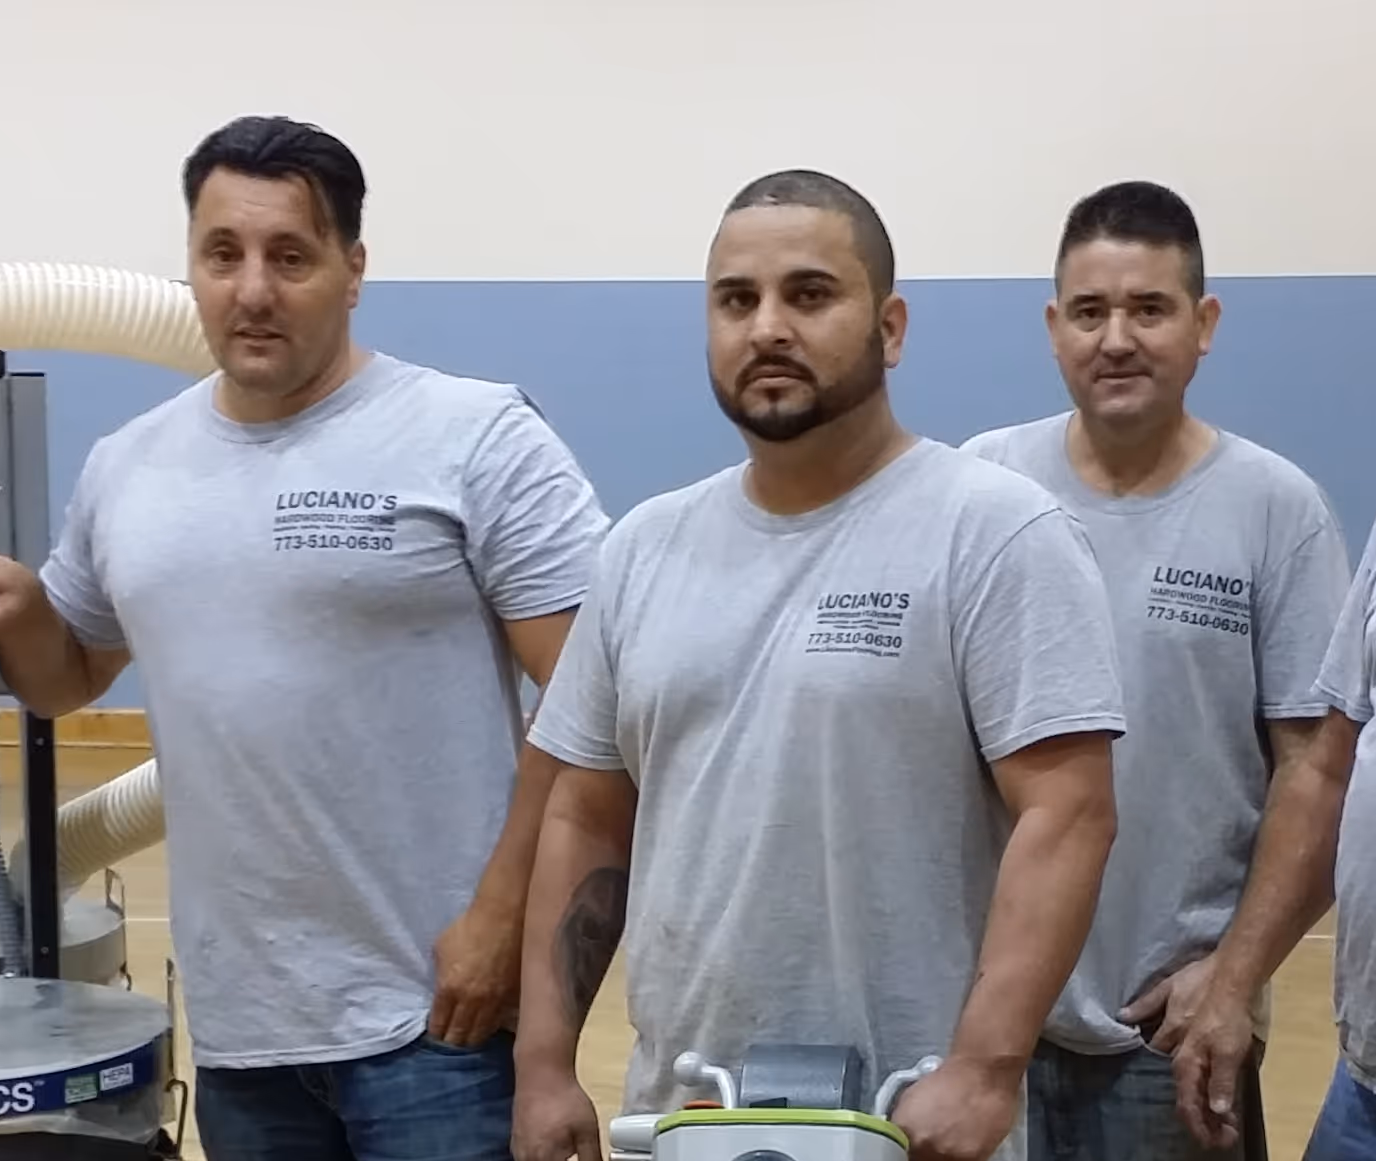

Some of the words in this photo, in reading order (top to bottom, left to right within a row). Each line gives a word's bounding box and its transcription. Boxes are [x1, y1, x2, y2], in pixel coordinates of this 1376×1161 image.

[276, 490, 398, 510] LUCIANO'S
[274, 534, 393, 551] 773-510-0630
[1153, 566, 1252, 596] LUCIANO'
[817, 591, 910, 610] LUCIANO'S
[1146, 605, 1249, 636] 773-510-0630
[807, 630, 903, 649] 773-510-0630
